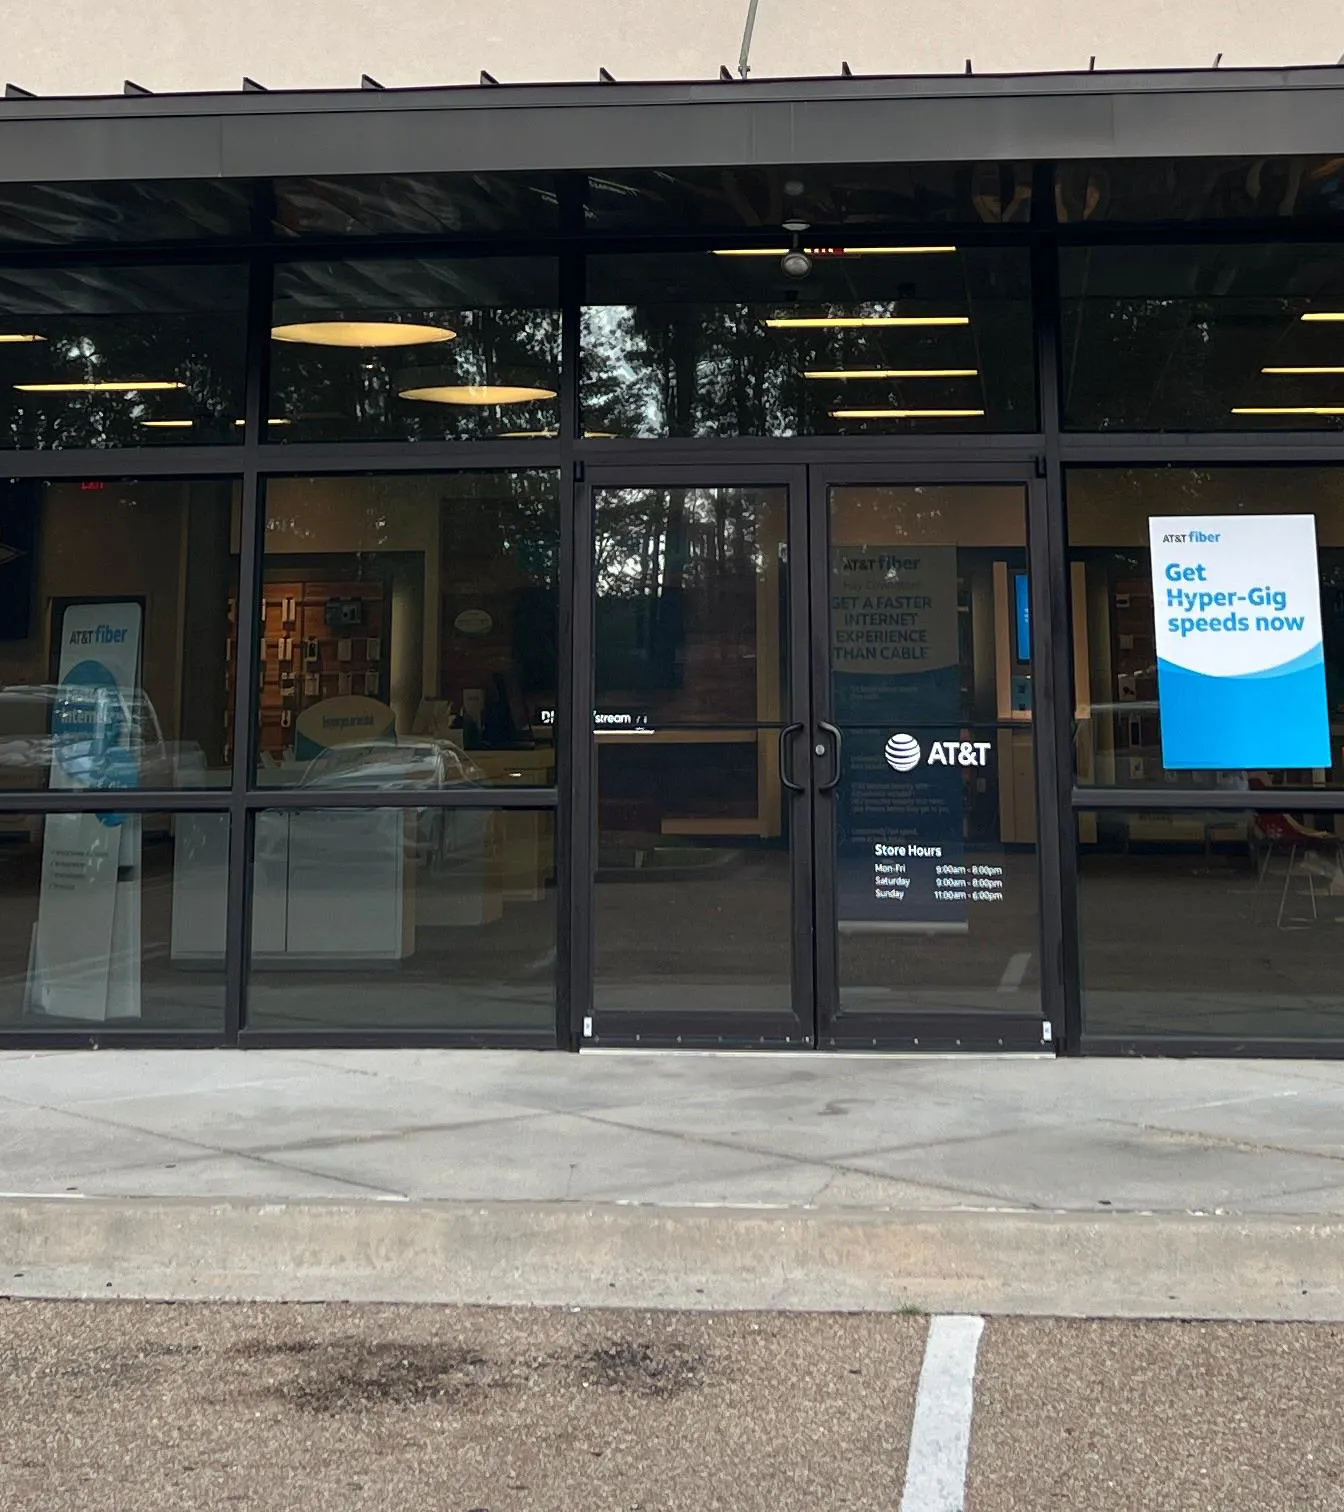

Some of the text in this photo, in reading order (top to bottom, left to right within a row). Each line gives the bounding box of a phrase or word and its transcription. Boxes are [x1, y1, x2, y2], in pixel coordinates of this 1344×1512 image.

[1162, 530, 1221, 543] AT&T fiber
[878, 554, 921, 571] fiber
[1165, 562, 1207, 582] Get
[832, 596, 932, 610] GET A FASTER
[1166, 585, 1287, 612] Hyper-Gig
[844, 612, 918, 626] INTERNET
[1168, 611, 1305, 638] speeds now
[69, 624, 128, 646] AT&T fiber
[836, 629, 928, 643] EXPERIENCE
[833, 646, 930, 660] THAN CABLE
[927, 741, 992, 767] AT&T
[874, 843, 943, 857] Store Hours
[874, 876, 911, 888] Saturday
[875, 889, 905, 901] Sunday
